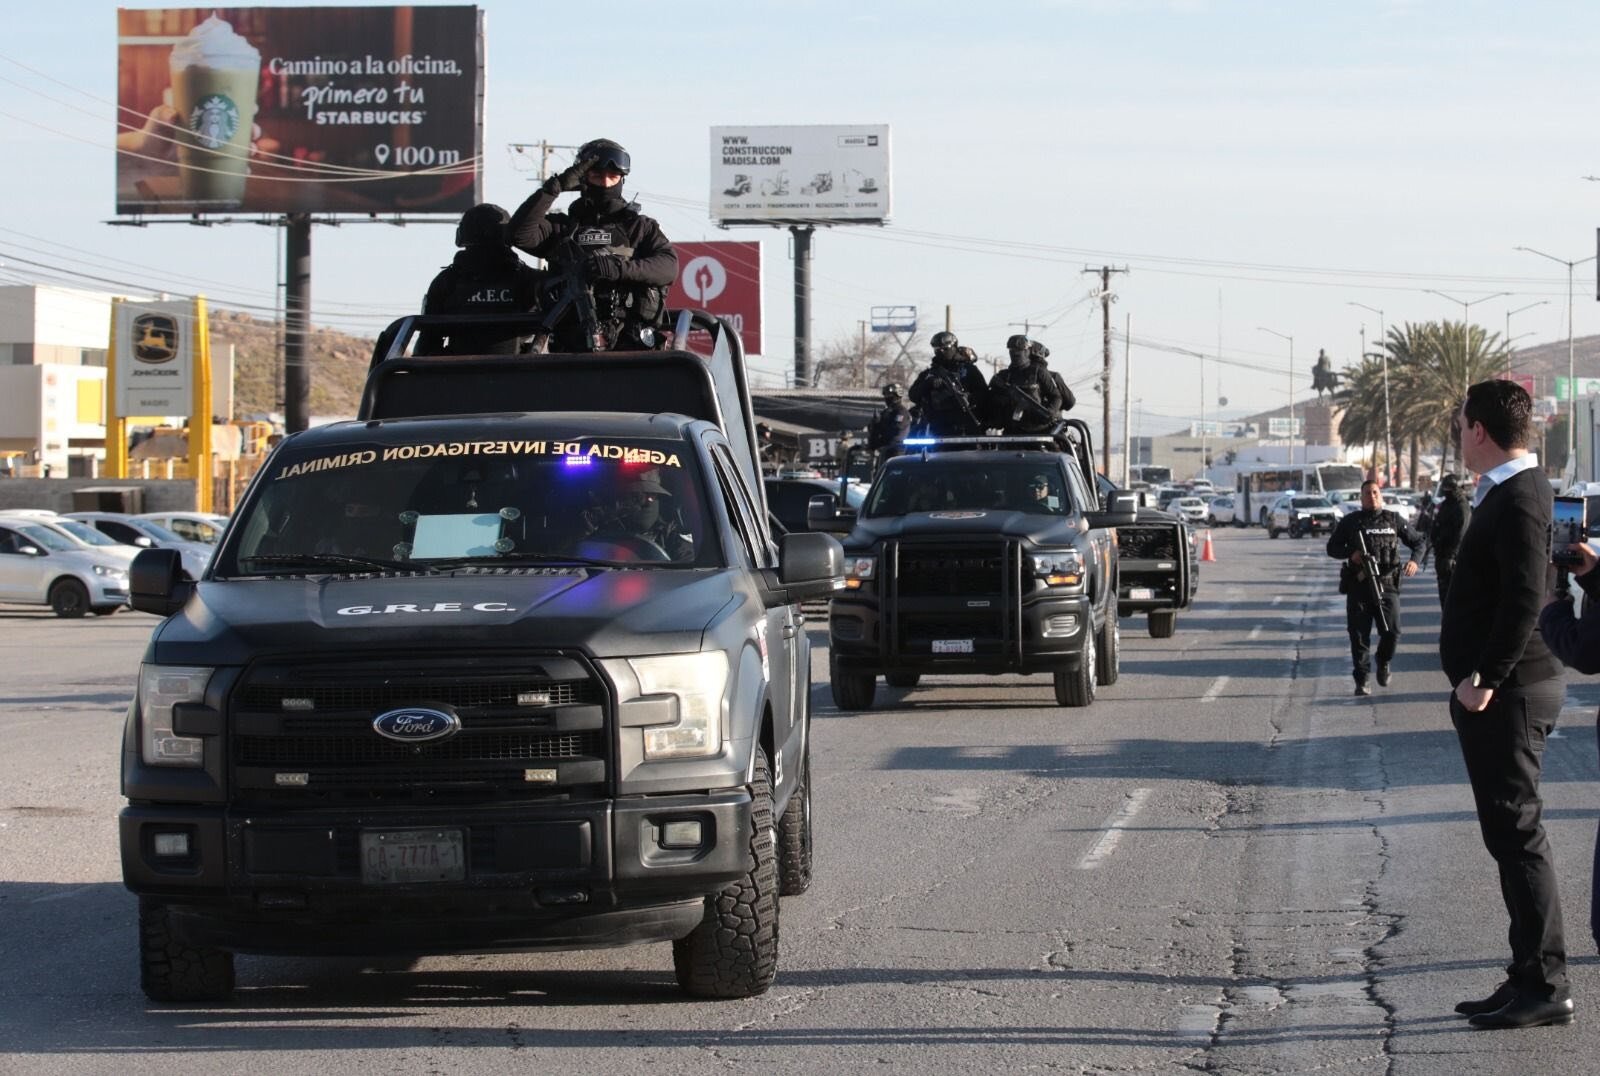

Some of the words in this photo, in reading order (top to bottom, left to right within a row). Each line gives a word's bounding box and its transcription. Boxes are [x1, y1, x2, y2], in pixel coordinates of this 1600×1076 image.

[269, 56, 347, 75] Camino
[350, 62, 362, 75] a
[365, 55, 384, 75] la
[387, 54, 462, 76] oficina,
[302, 82, 388, 120] primero
[393, 80, 424, 104] tu
[316, 111, 424, 125] STARBUCKS
[722, 136, 749, 145] WWW.
[395, 146, 434, 165] 100
[438, 150, 460, 165] m
[722, 146, 792, 155] CONSTRUCCION
[722, 156, 781, 166] MADISA.COM
[337, 602, 517, 616] G.R.EC.
[392, 715, 436, 733] Ford
